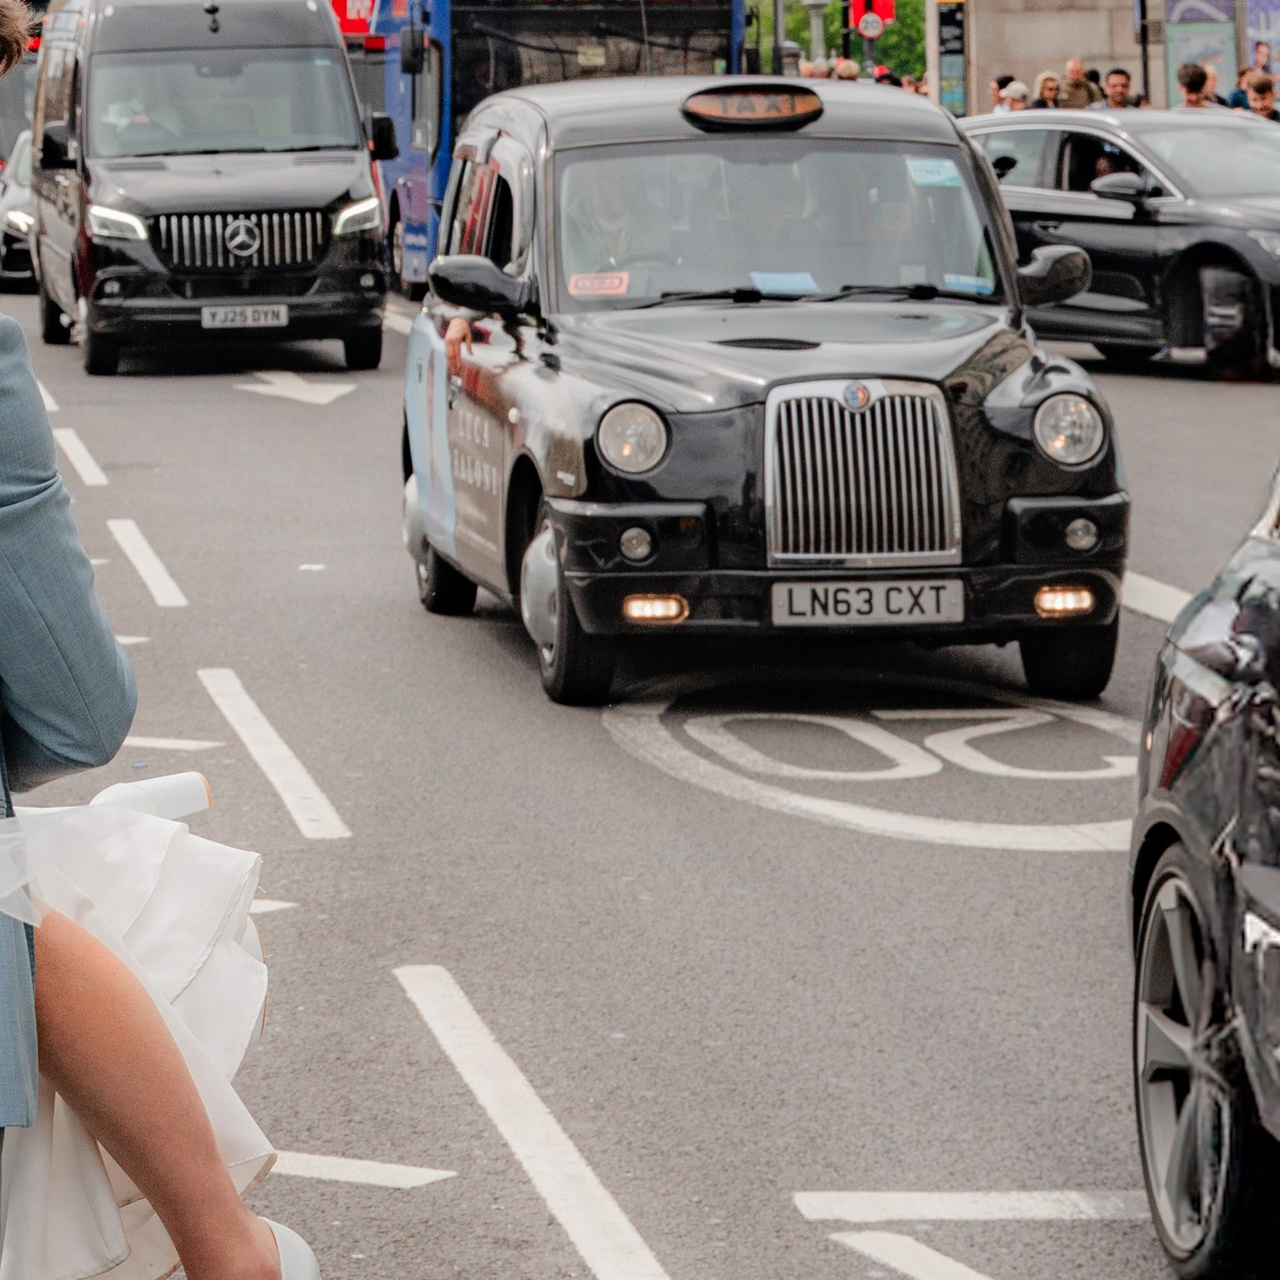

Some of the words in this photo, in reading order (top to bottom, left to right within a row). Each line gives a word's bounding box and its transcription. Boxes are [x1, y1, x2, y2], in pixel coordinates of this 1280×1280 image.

[718, 94, 796, 115] TAXI
[209, 310, 247, 322] YJ25
[252, 310, 280, 322] DYN
[787, 587, 874, 616] LN63
[885, 585, 946, 615] CXT
